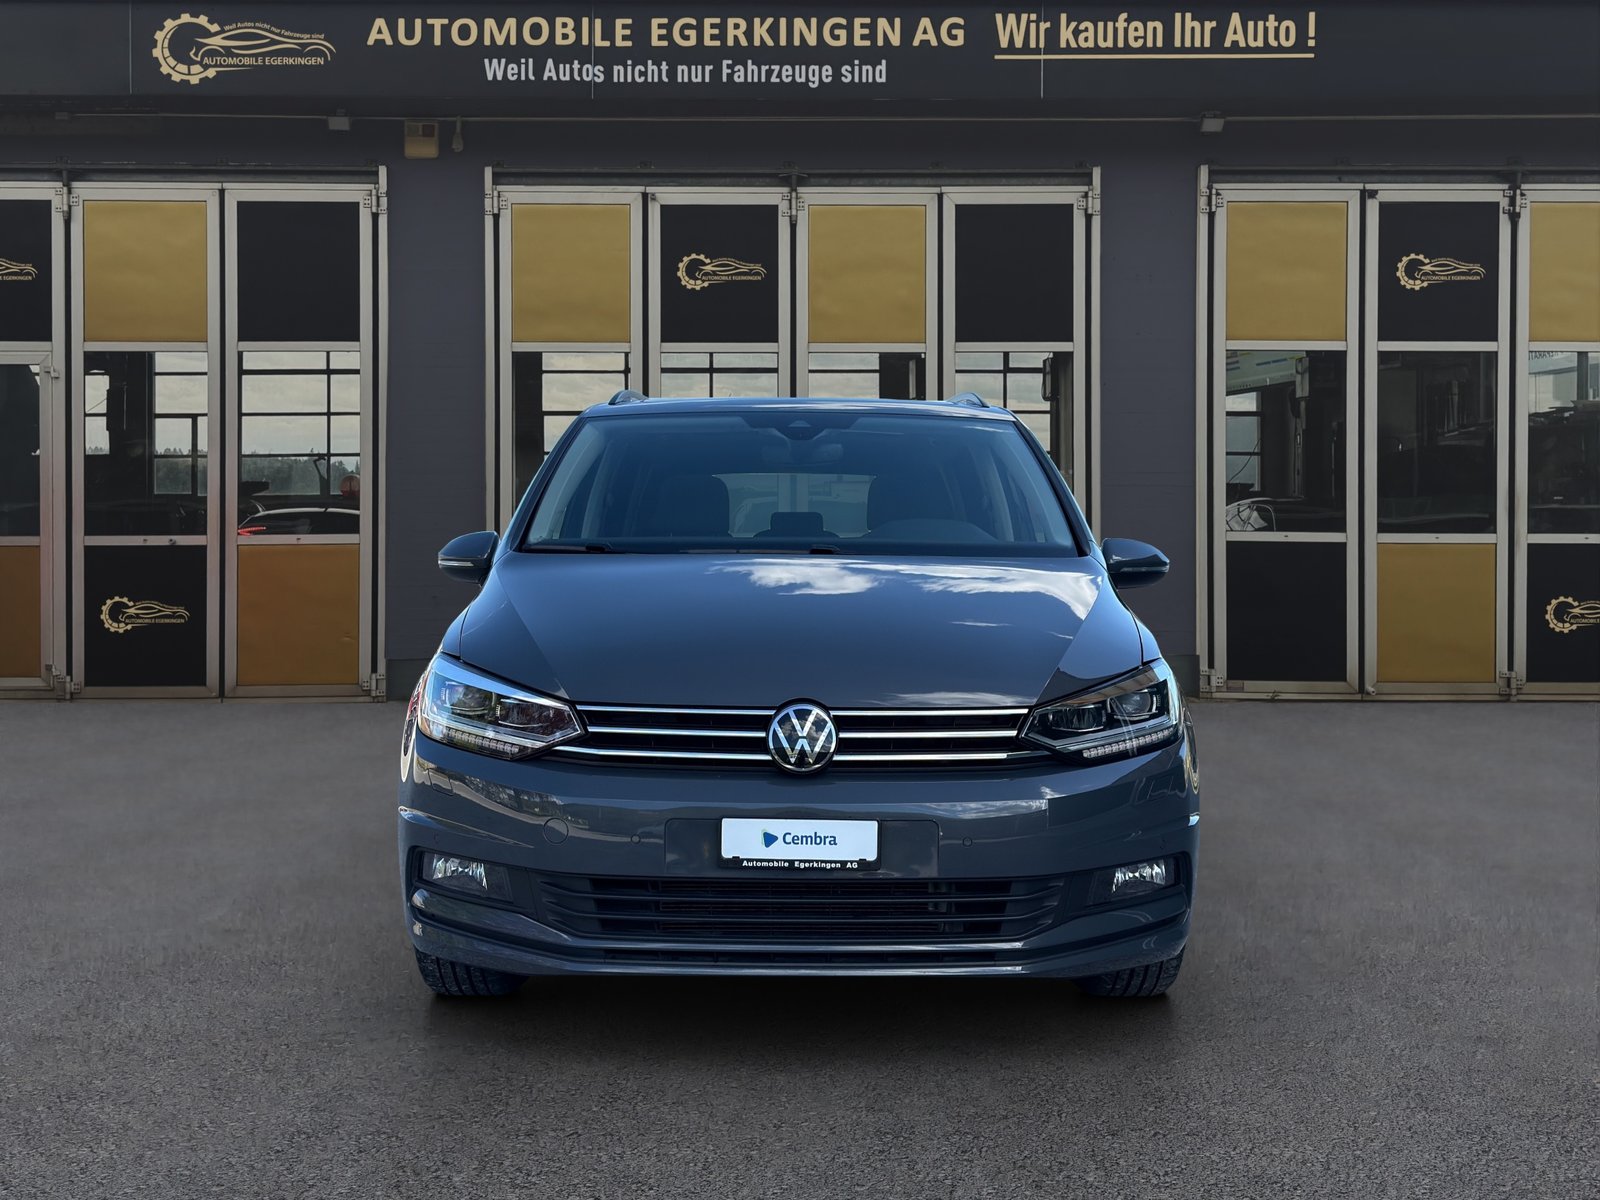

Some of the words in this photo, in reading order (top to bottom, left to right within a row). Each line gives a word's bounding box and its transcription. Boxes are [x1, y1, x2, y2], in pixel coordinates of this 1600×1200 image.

[223, 22, 237, 31] Weil
[255, 21, 271, 30] nicht
[281, 29, 311, 39] Fahrzeuge
[366, 16, 633, 47] AUTOMOBILE
[650, 17, 901, 47] EGERKINGEN
[912, 17, 965, 47] AG
[995, 12, 1051, 49] Wir
[1059, 12, 1164, 48] kaufen
[1174, 12, 1216, 48] Ihr
[1223, 11, 1297, 48] Auto
[1307, 11, 1316, 47] !
[202, 56, 264, 66] AUTOMOBILE
[265, 56, 324, 66] EGERKINGEN
[484, 58, 535, 81] Weil
[543, 58, 605, 83] Autos
[613, 60, 669, 83] nicht
[677, 64, 714, 83] nur
[722, 60, 833, 88] Fahrzeuge
[841, 60, 887, 83] sind
[769, 704, 835, 769] VW
[782, 831, 838, 846] Cembra
[742, 860, 789, 868] Automobile
[794, 861, 841, 869] Egerkingen
